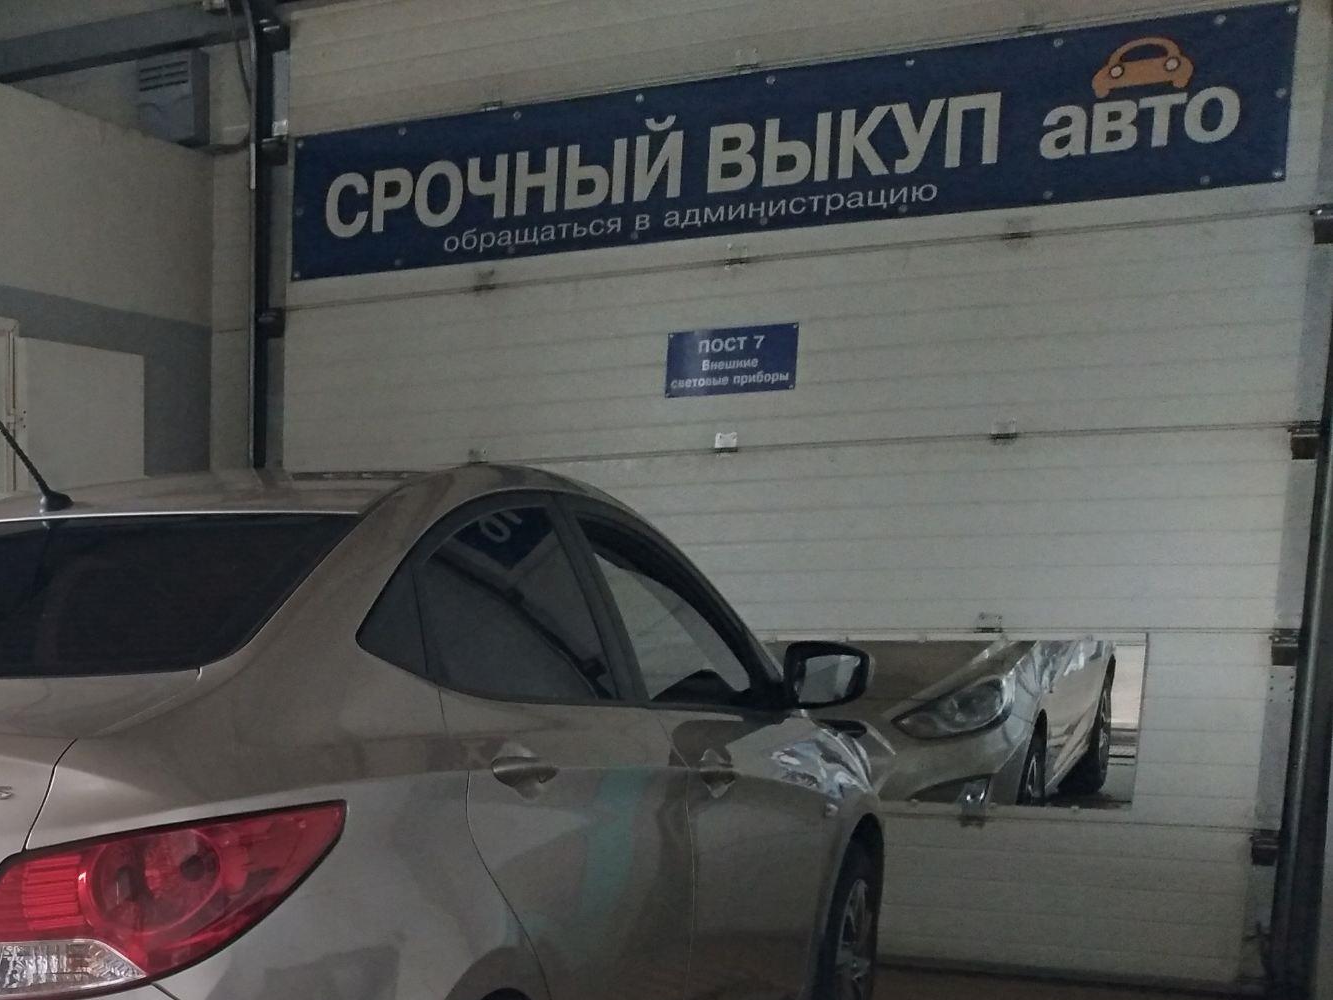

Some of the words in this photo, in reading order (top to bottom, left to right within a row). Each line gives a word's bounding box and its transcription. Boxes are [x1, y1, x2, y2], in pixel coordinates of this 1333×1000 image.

[325, 115, 684, 238] СРОЧНЫЙ
[706, 91, 1003, 195] ВЫКУП
[1039, 86, 1241, 161] авто
[443, 217, 622, 253] обращаться
[635, 213, 650, 232] в
[663, 182, 938, 228] администрацию
[698, 336, 747, 353] ПОСТ
[754, 334, 765, 350] 7
[701, 358, 759, 371] Внешние
[670, 375, 729, 389] световые
[733, 370, 790, 386] приборы
